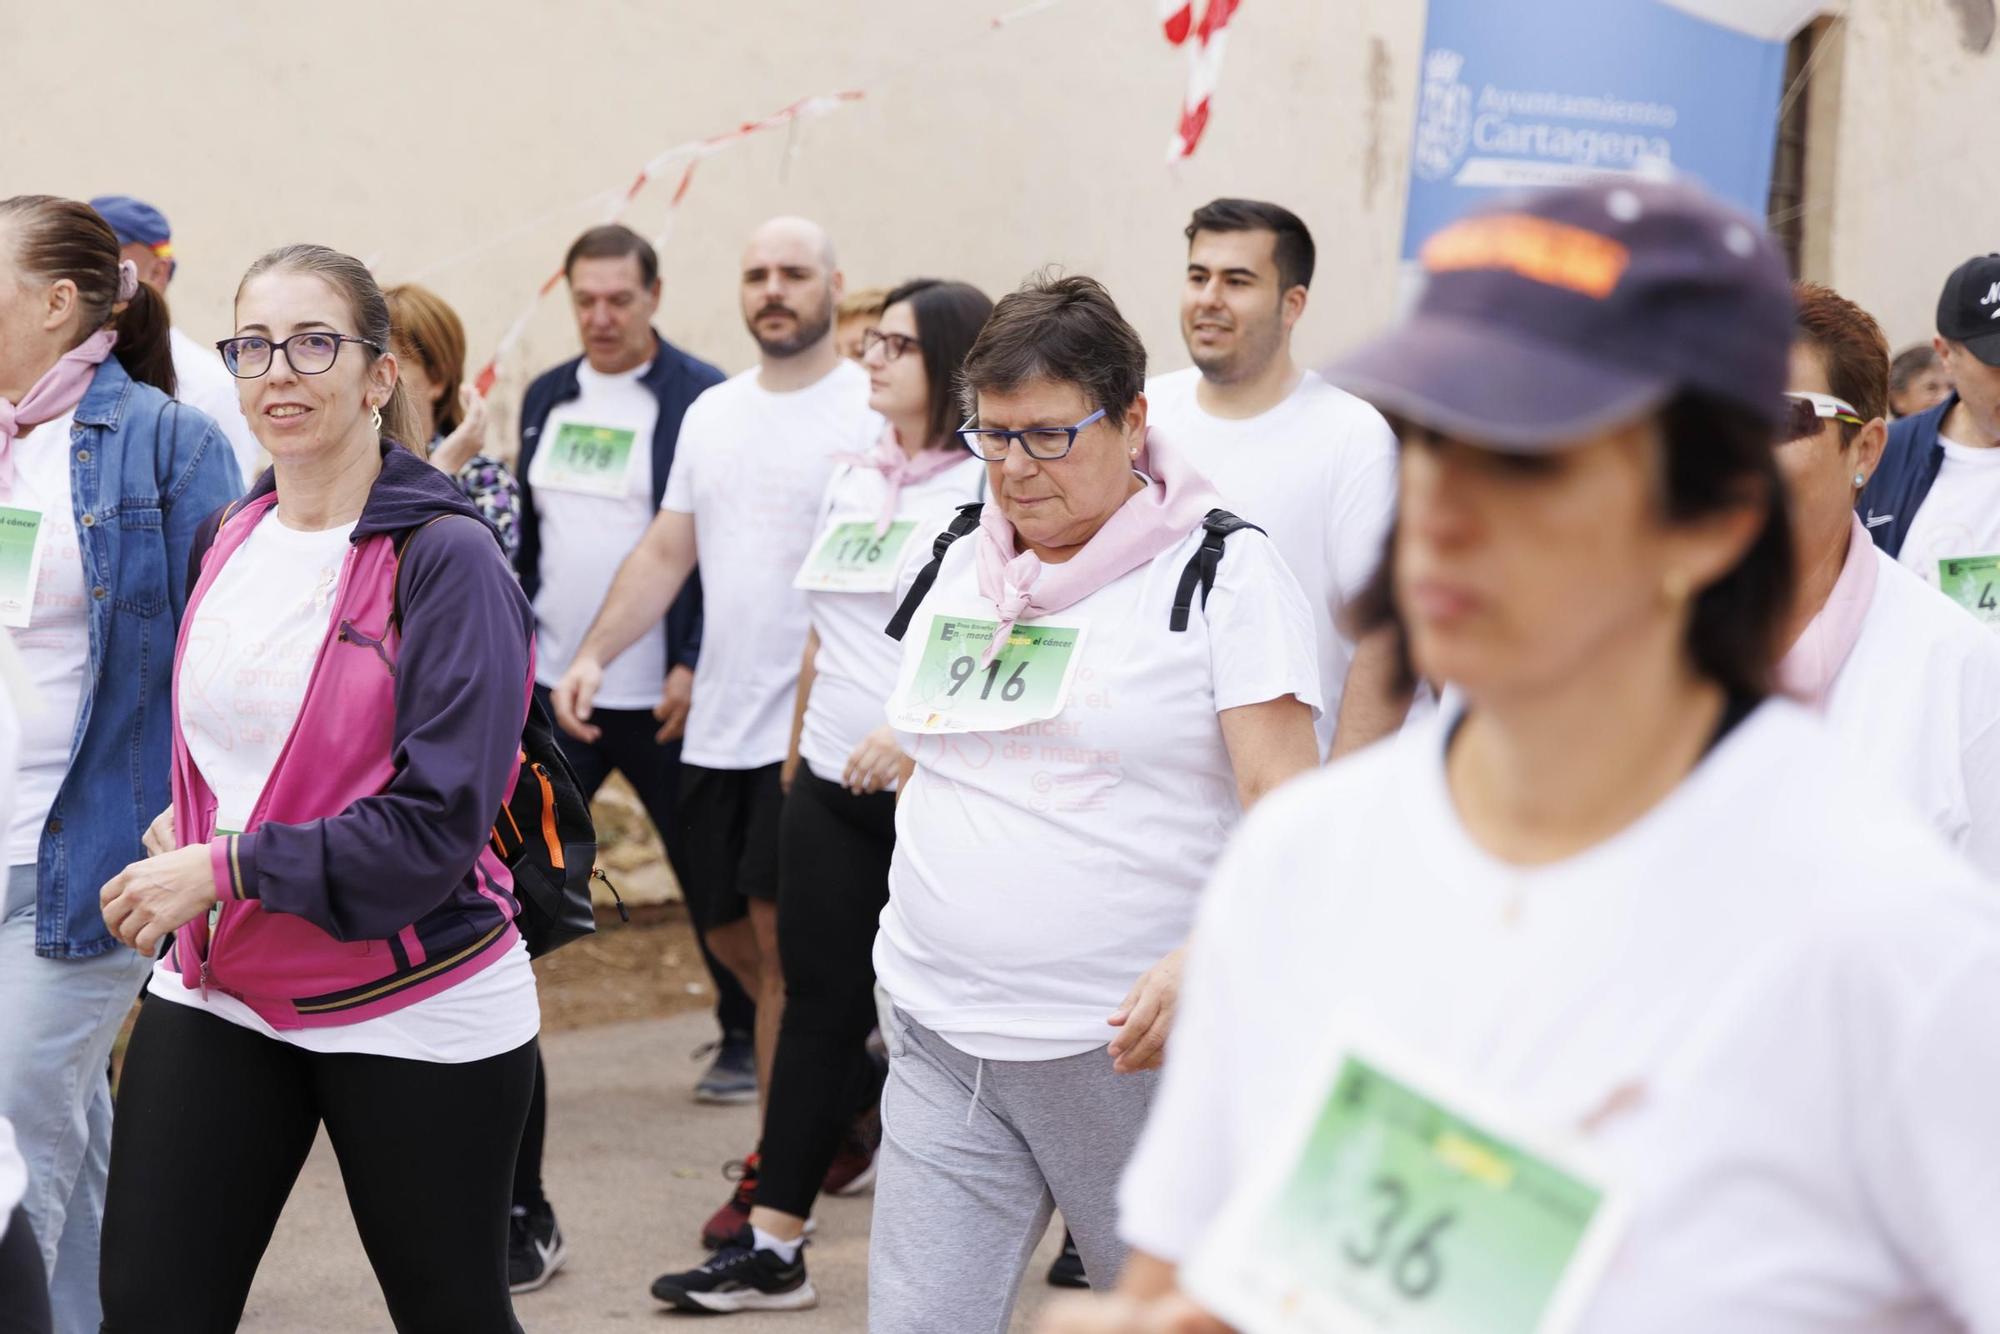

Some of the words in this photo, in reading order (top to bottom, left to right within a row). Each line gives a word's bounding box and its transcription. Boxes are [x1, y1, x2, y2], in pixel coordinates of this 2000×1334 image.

[1478, 83, 1677, 129] Ayuntamiento
[1473, 113, 1672, 165] Cartagena
[568, 441, 613, 471] 198
[7, 517, 37, 528] cáncer
[836, 537, 886, 562] 176
[966, 632, 994, 641] march
[1043, 639, 1072, 648] cáncer
[947, 655, 1029, 701] 916
[1000, 720, 1083, 737] ncer
[1002, 739, 1033, 760] de
[1039, 744, 1121, 764] mama
[1342, 1173, 1457, 1300] 36
